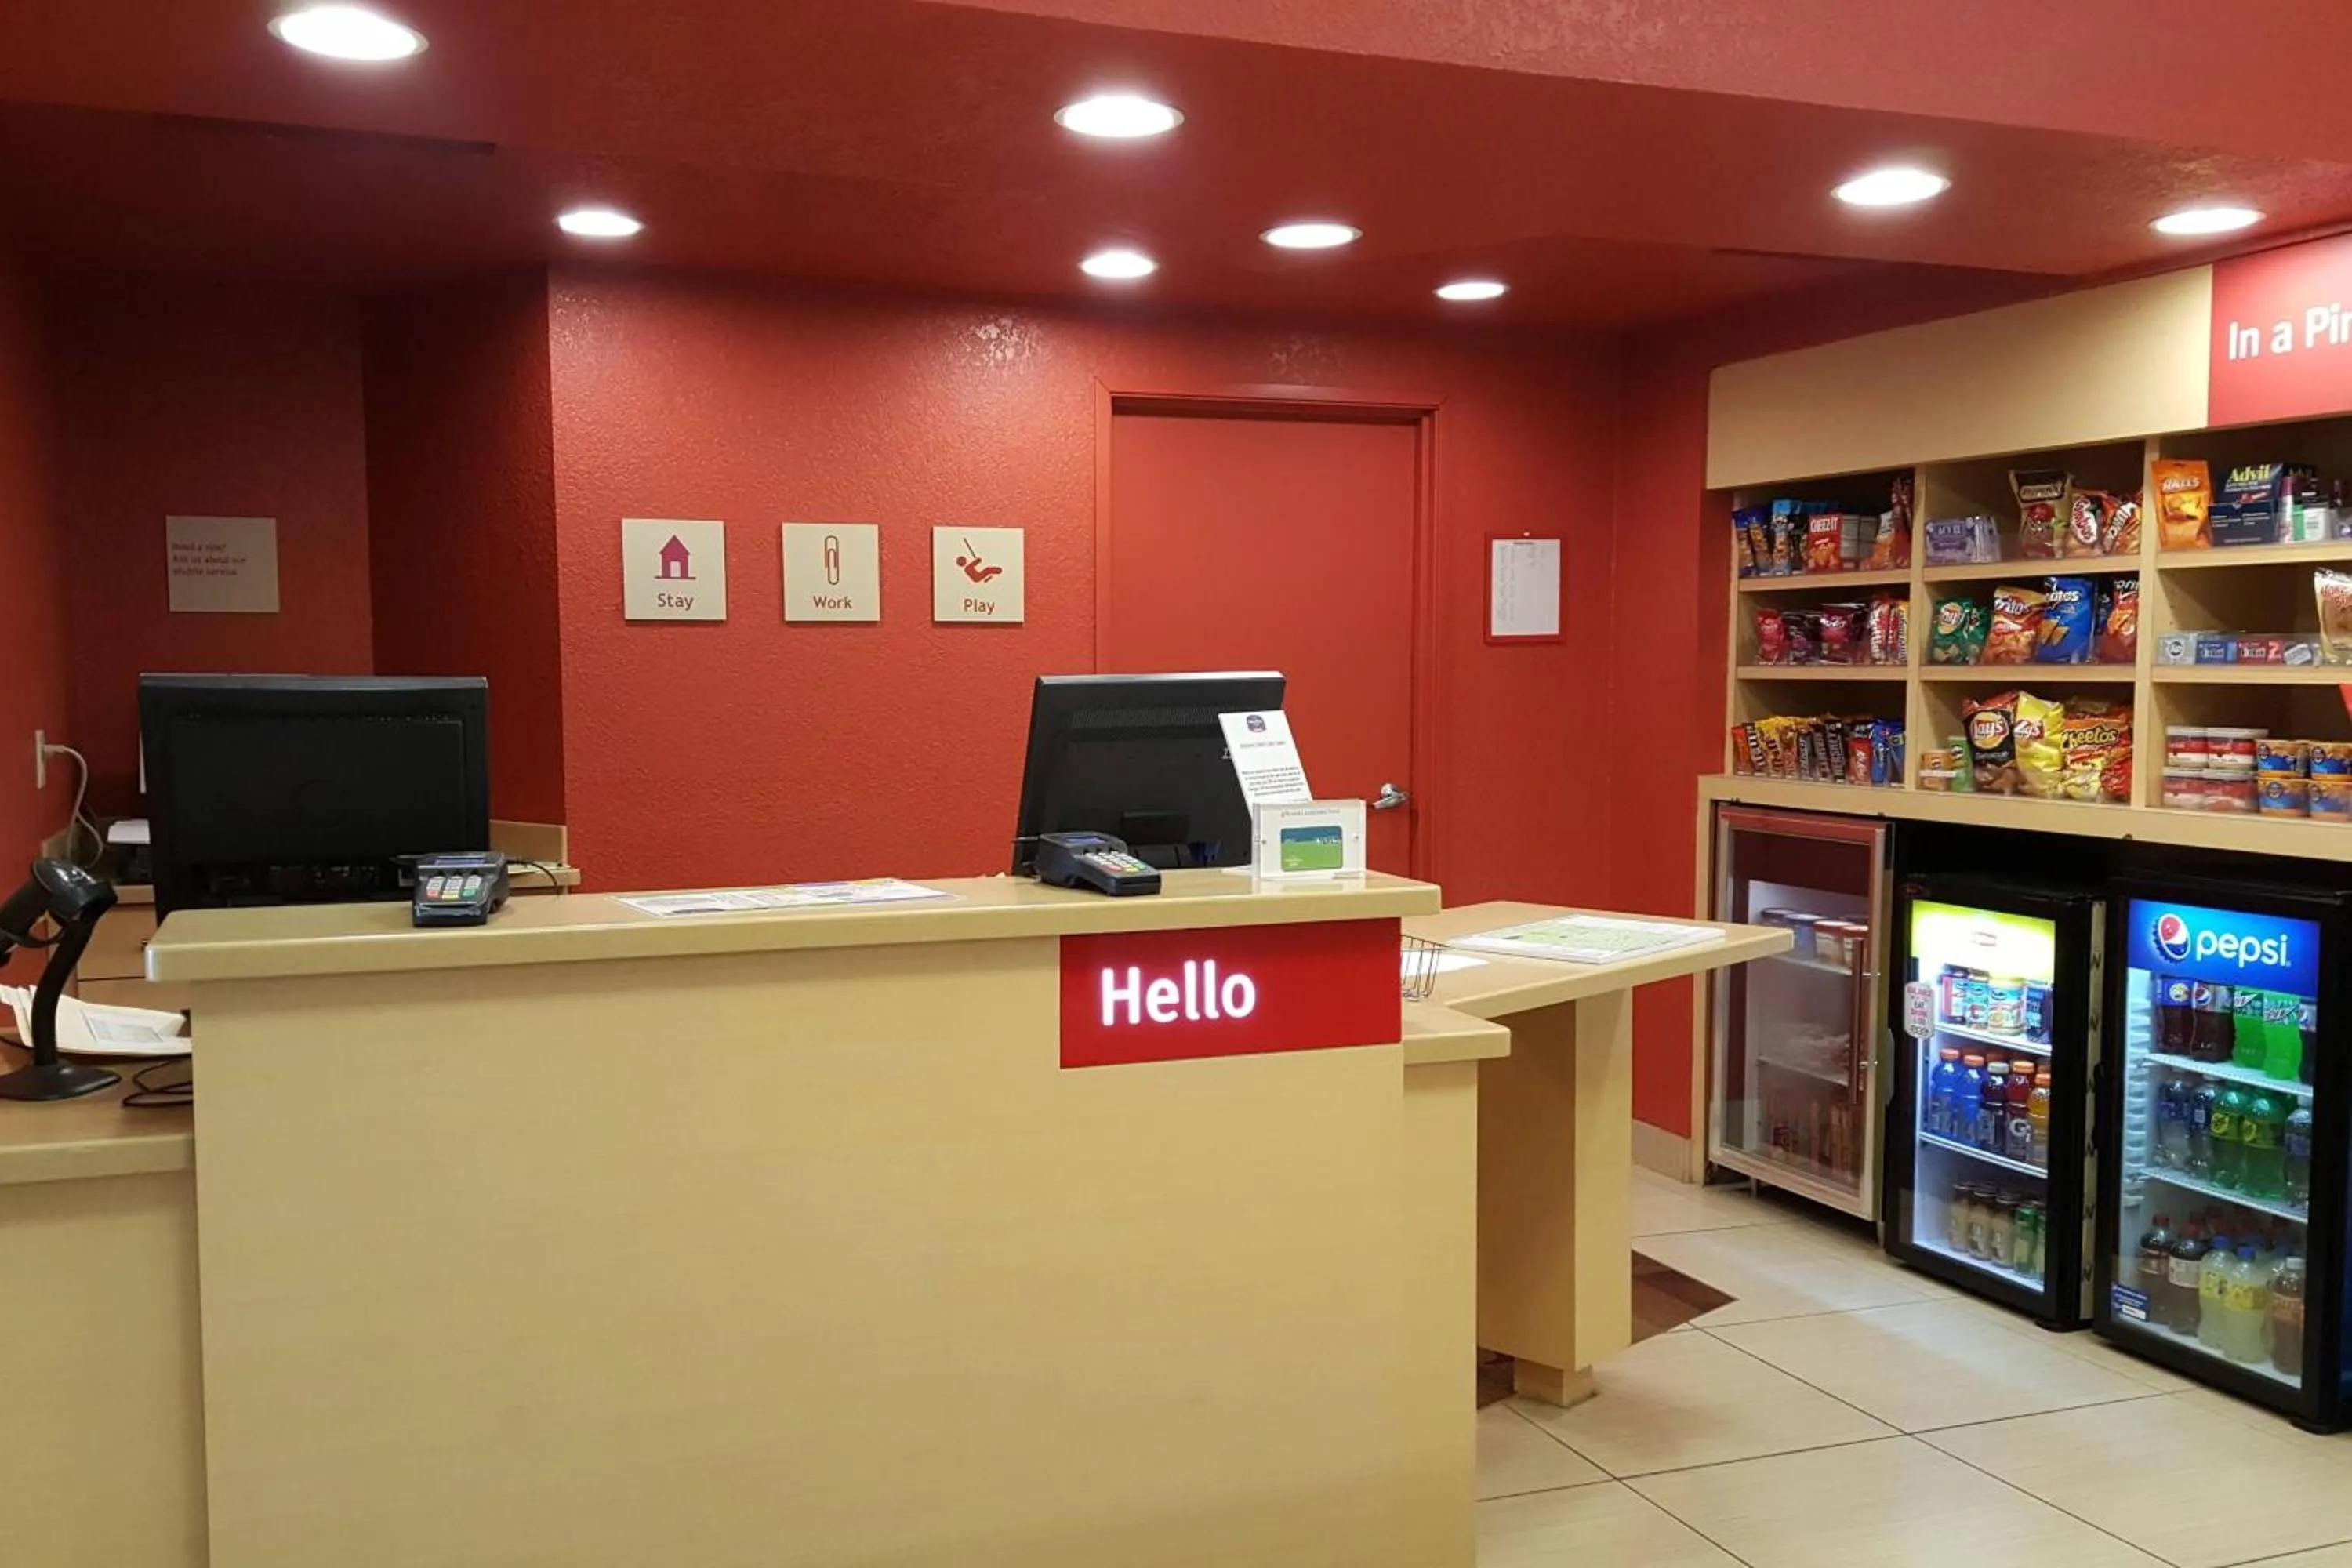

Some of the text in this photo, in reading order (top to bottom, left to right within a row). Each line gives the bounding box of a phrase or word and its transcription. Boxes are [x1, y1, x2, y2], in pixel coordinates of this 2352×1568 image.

[2229, 321, 2259, 361] In
[2271, 321, 2292, 353] a
[2228, 463, 2271, 482] Advil
[2161, 477, 2199, 491] HALLS
[657, 593, 694, 610] Stay
[813, 595, 853, 610] Work
[964, 598, 996, 615] Play
[1973, 718, 2008, 739] Lay's
[2061, 726, 2118, 750] Cheetos
[2196, 930, 2288, 968] pepsi
[1101, 959, 1256, 1026] Hello
